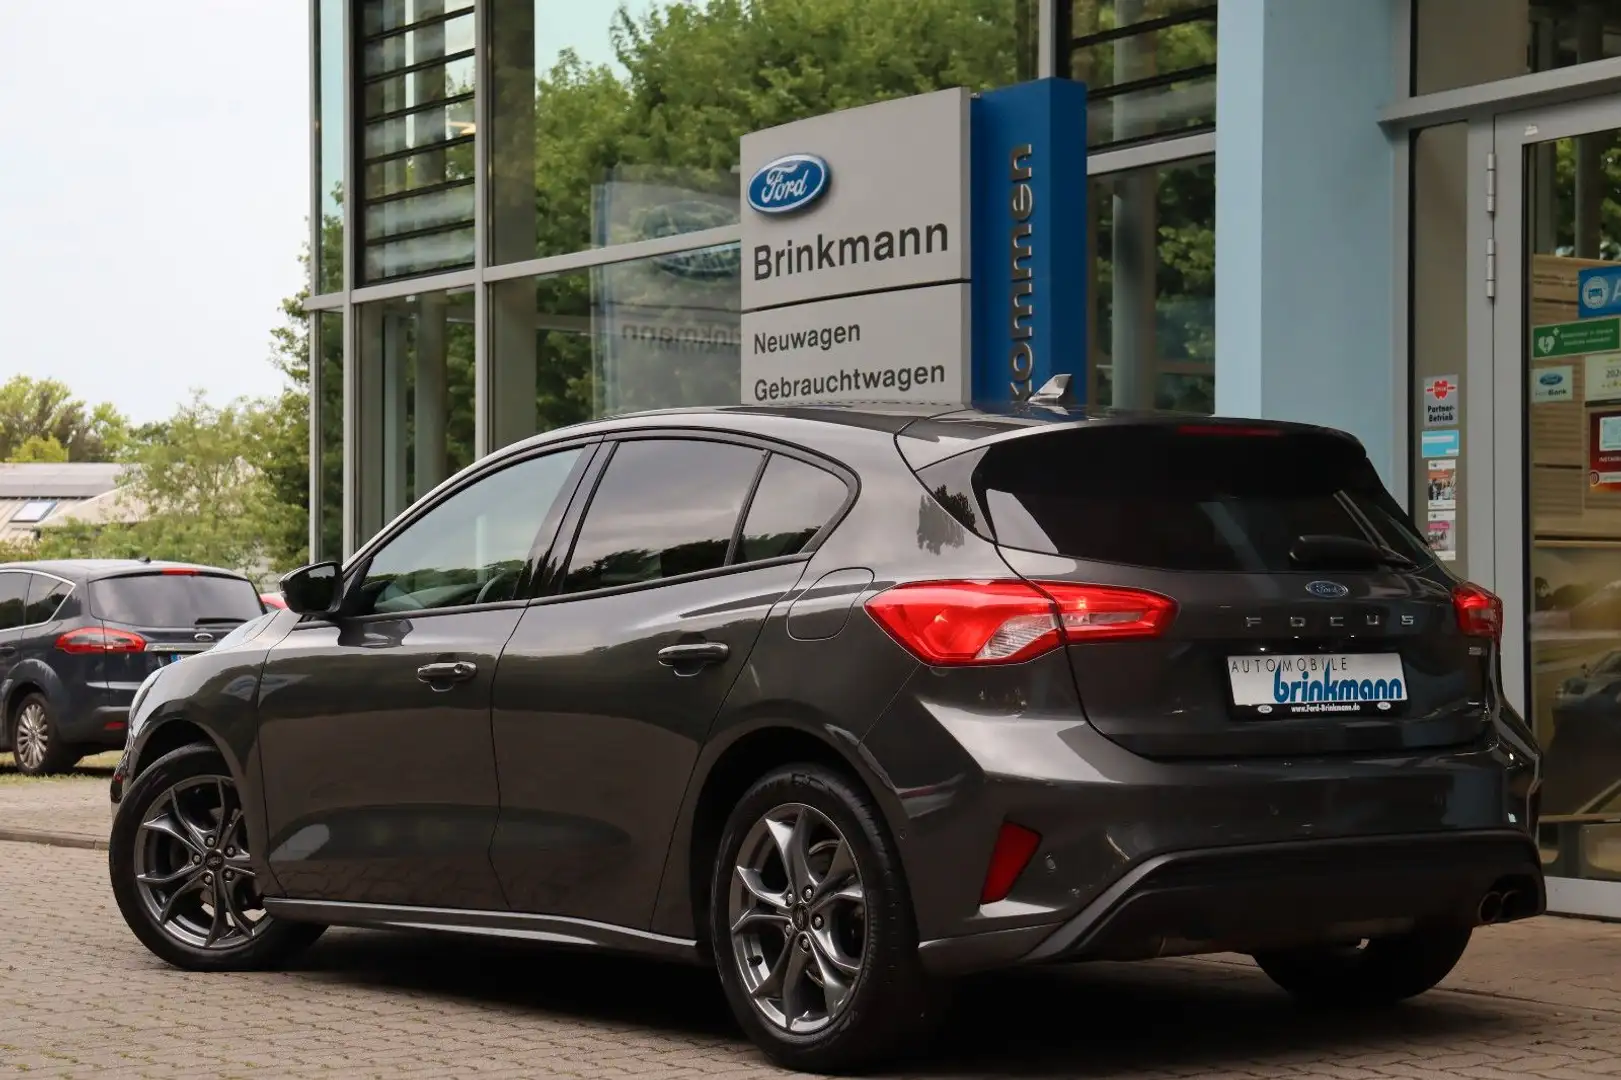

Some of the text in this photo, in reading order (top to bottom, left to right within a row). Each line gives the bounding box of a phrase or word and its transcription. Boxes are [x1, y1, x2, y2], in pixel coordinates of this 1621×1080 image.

[754, 222, 948, 281] Brinkmann
[754, 323, 861, 355] Neuwagen
[754, 363, 945, 401] Gebrauchtwagen
[1429, 412, 1454, 422] Betrieb
[1246, 614, 1414, 627] FOCUS
[1231, 658, 1347, 673] AUTOMOBILE
[1273, 659, 1402, 703] brinkmann
[1290, 703, 1361, 713] www.Ford-Brinkmann.de
